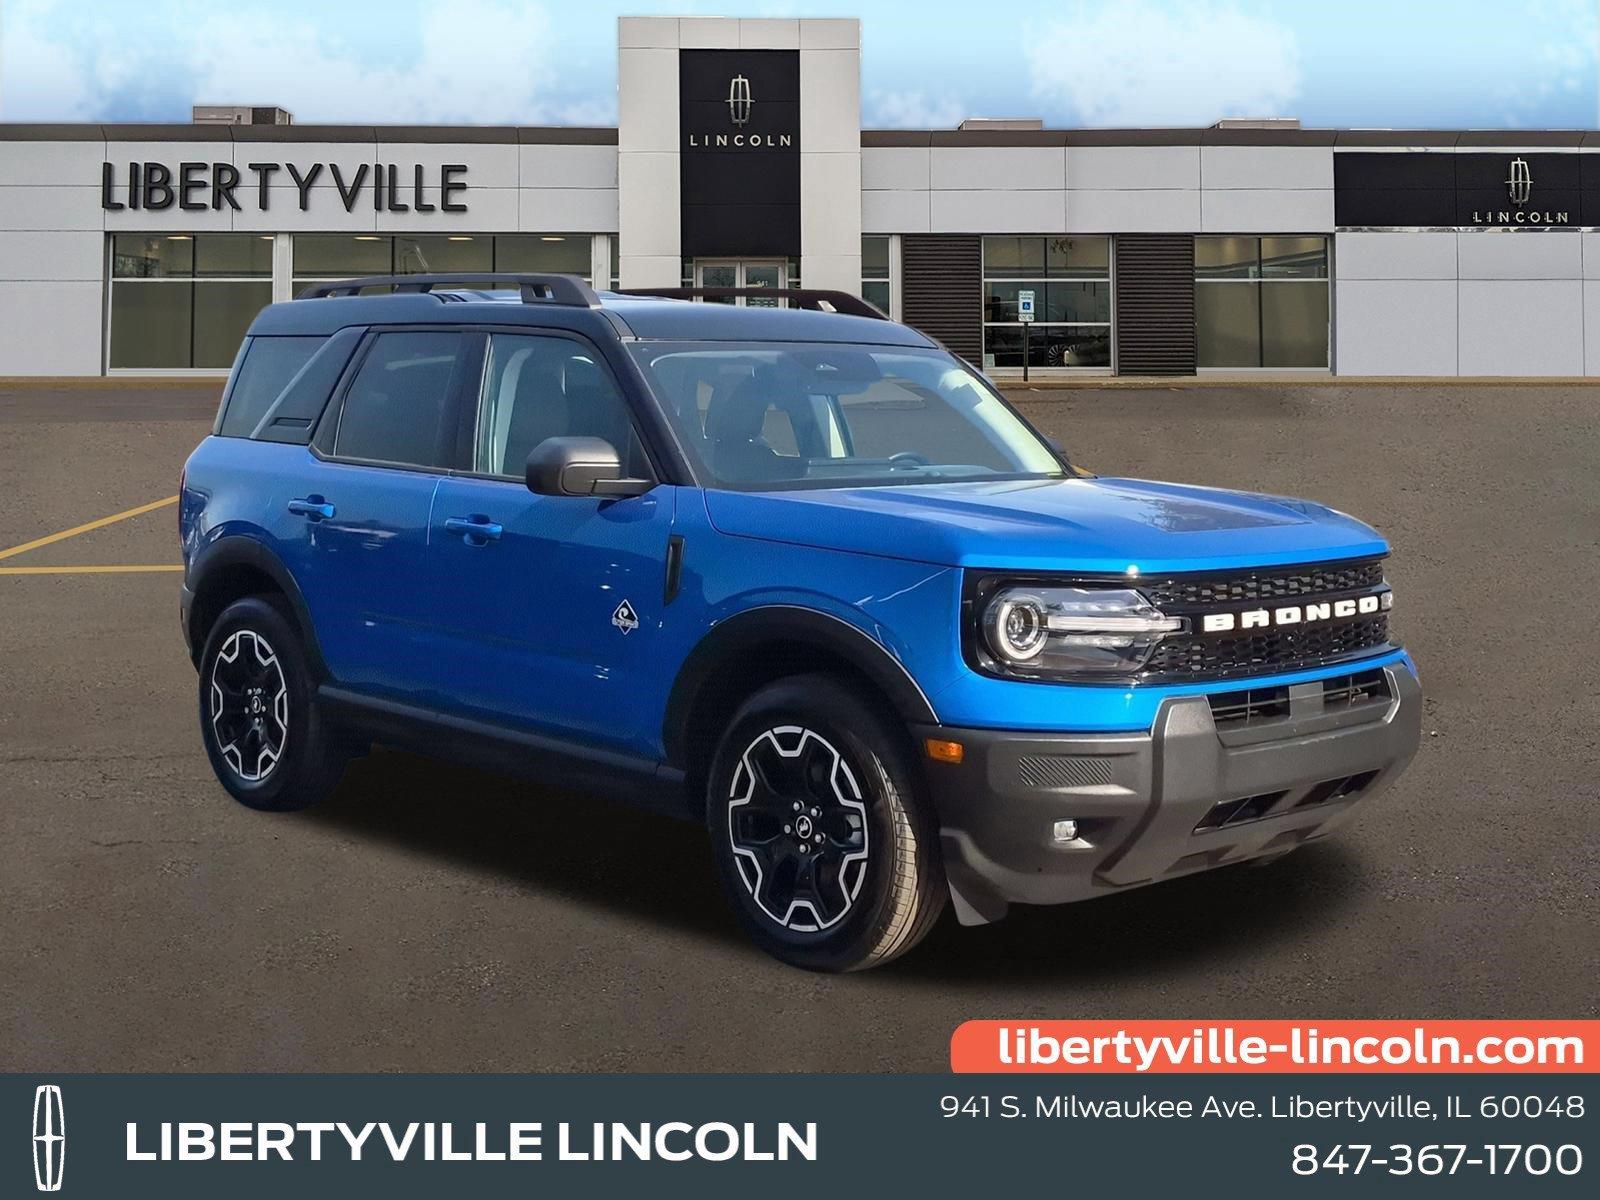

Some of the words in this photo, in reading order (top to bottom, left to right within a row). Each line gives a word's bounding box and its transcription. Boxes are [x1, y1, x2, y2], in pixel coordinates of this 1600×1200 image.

[690, 135, 791, 147] LINCOLN
[102, 162, 468, 213] LIBERTYVILLE
[1473, 211, 1568, 223] LINCOLN
[1204, 596, 1378, 632] BRONCO
